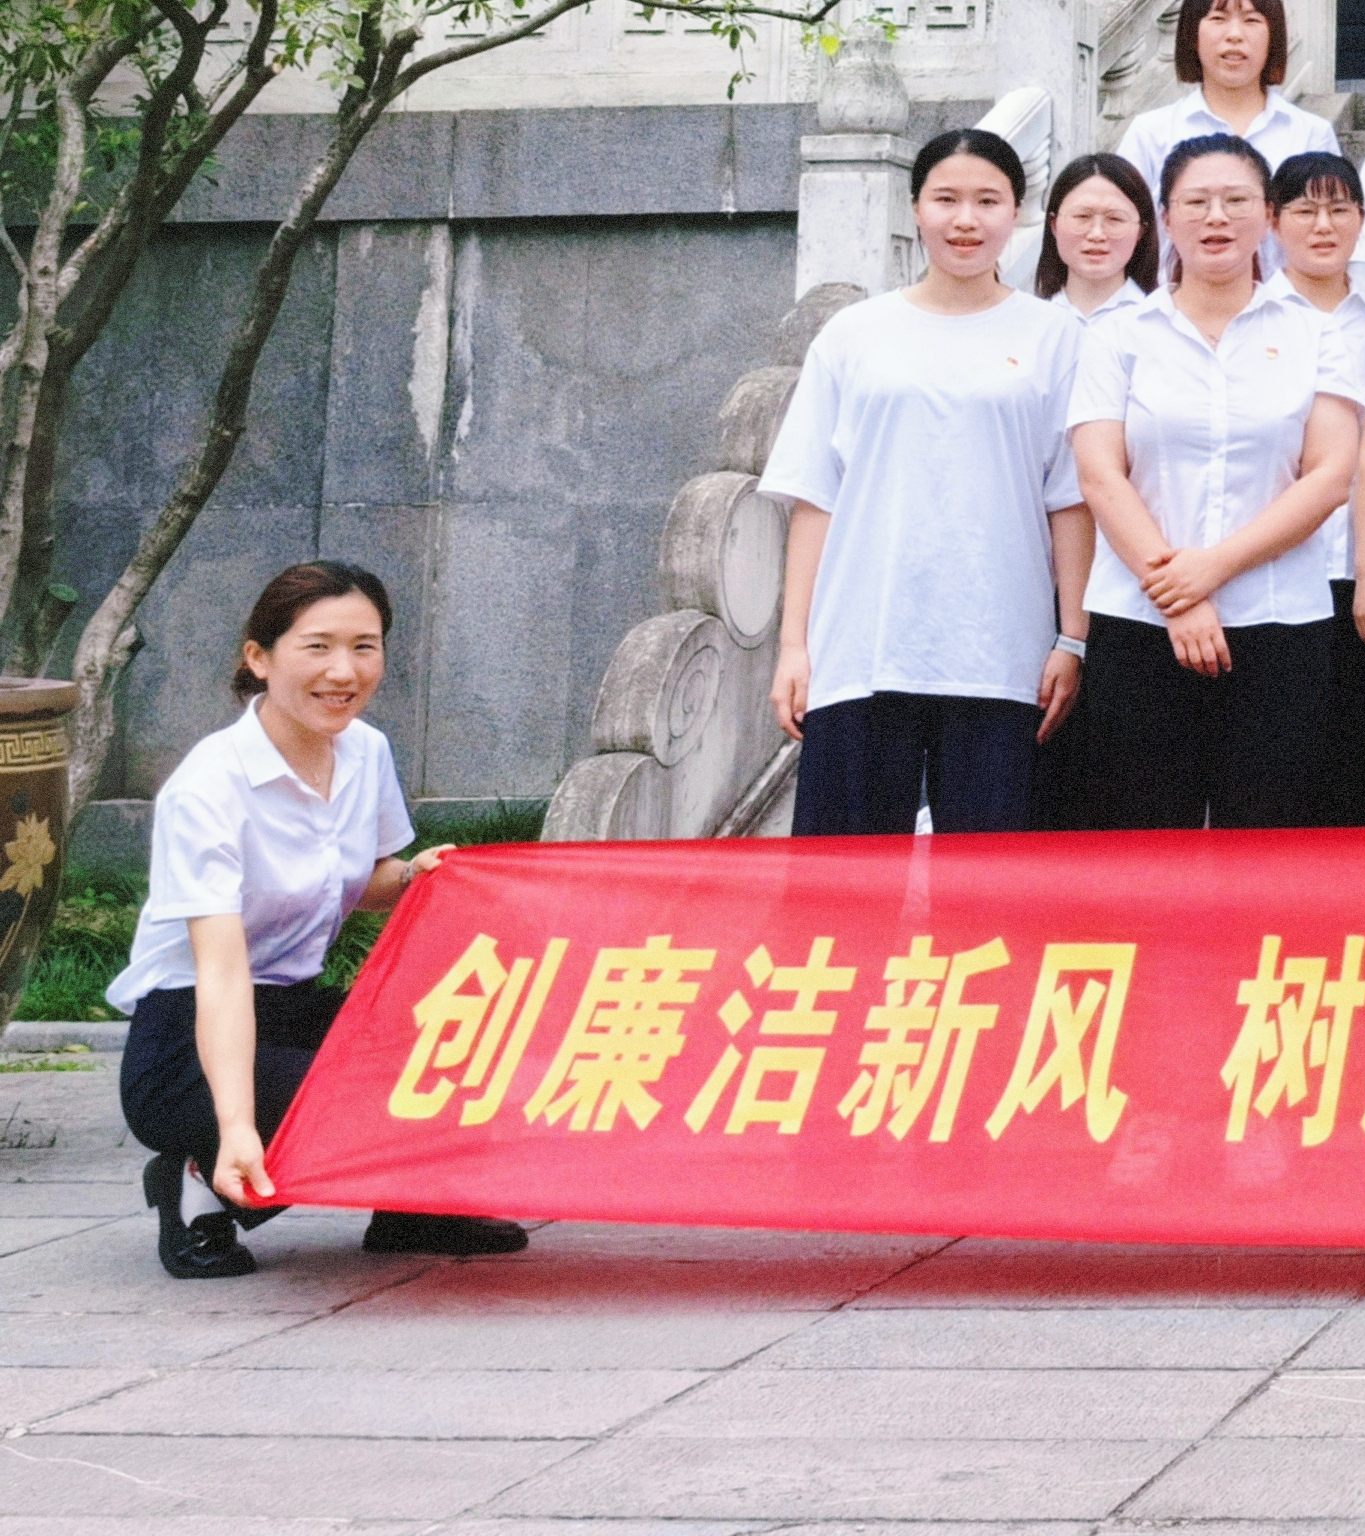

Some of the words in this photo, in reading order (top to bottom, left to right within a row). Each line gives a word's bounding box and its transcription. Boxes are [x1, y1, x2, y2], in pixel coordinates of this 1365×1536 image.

[387, 932, 1138, 1145] 创廉洁新风
